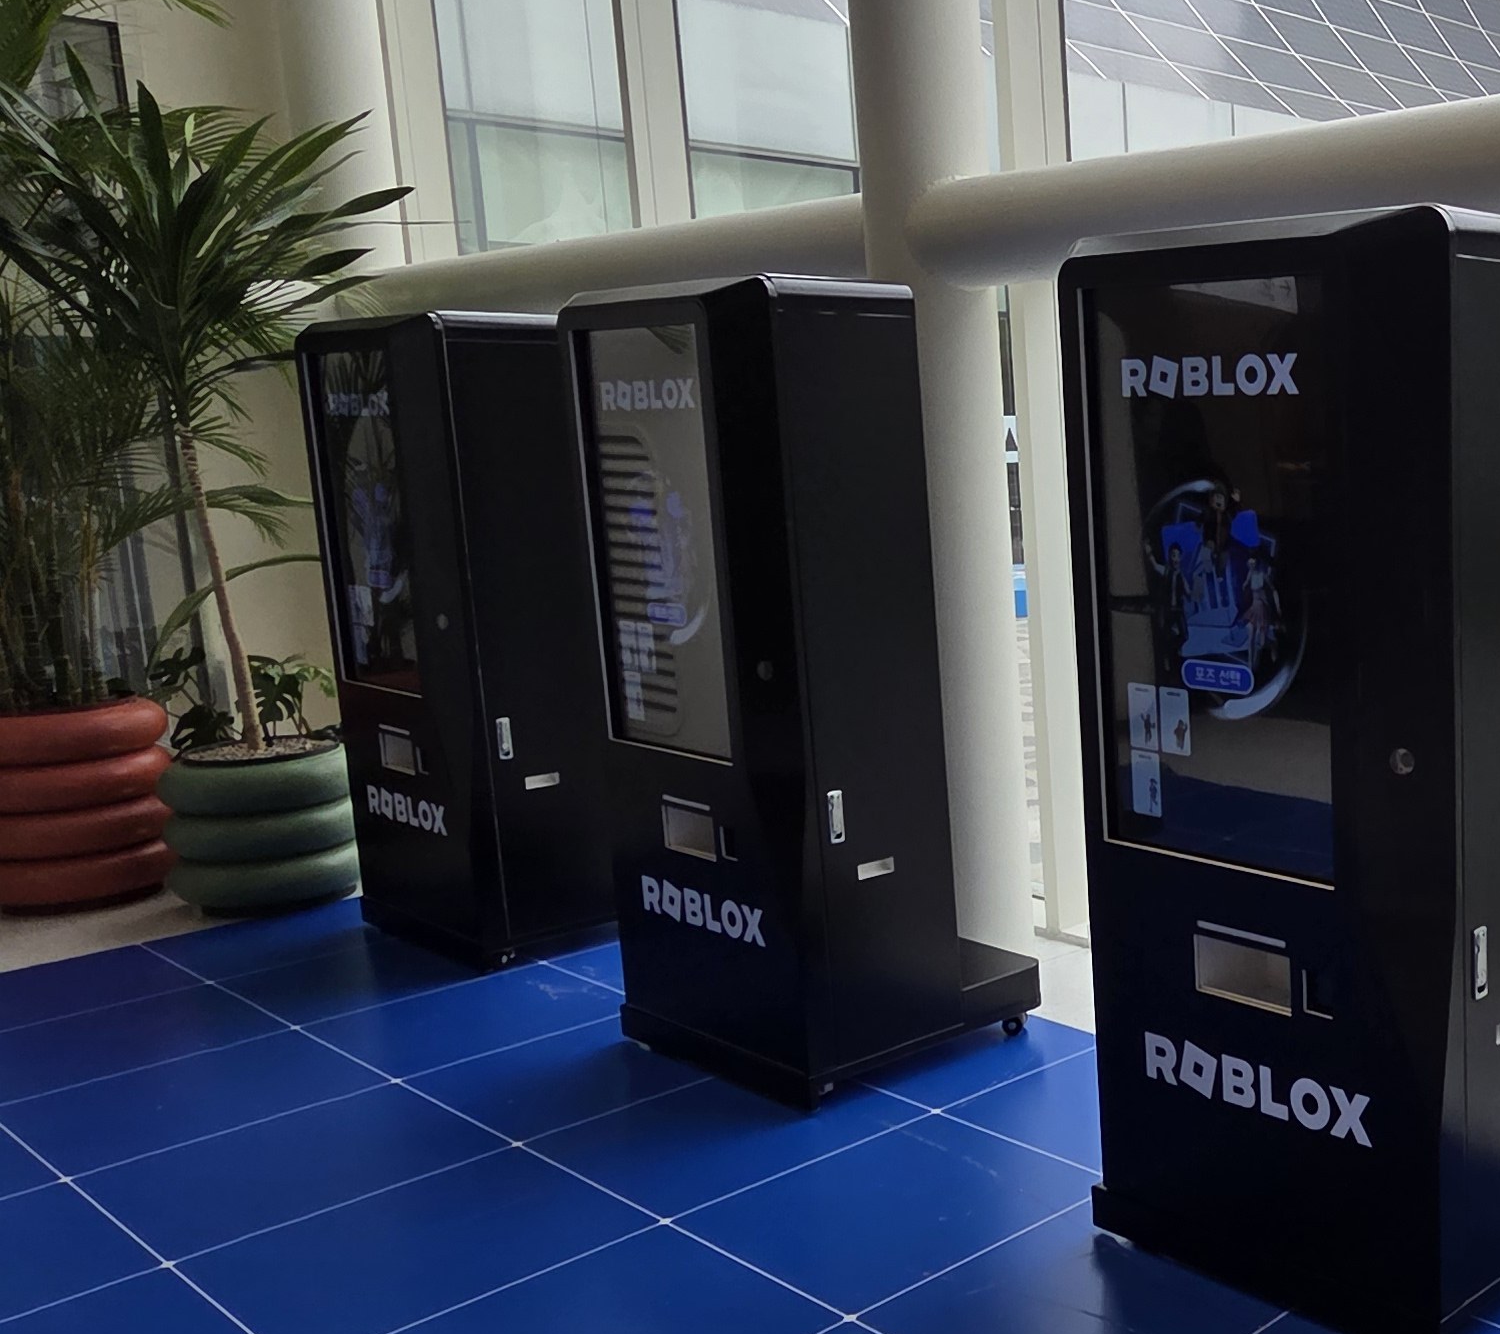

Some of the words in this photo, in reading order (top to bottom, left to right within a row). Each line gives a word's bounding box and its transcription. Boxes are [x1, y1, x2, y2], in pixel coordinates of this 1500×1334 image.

[600, 378, 696, 411] ROBLOX
[1121, 353, 1300, 399] ROBLOX
[366, 784, 448, 837] ROBLOX
[641, 874, 766, 948] ROBLOX
[1144, 1031, 1373, 1148] ROBLOX
